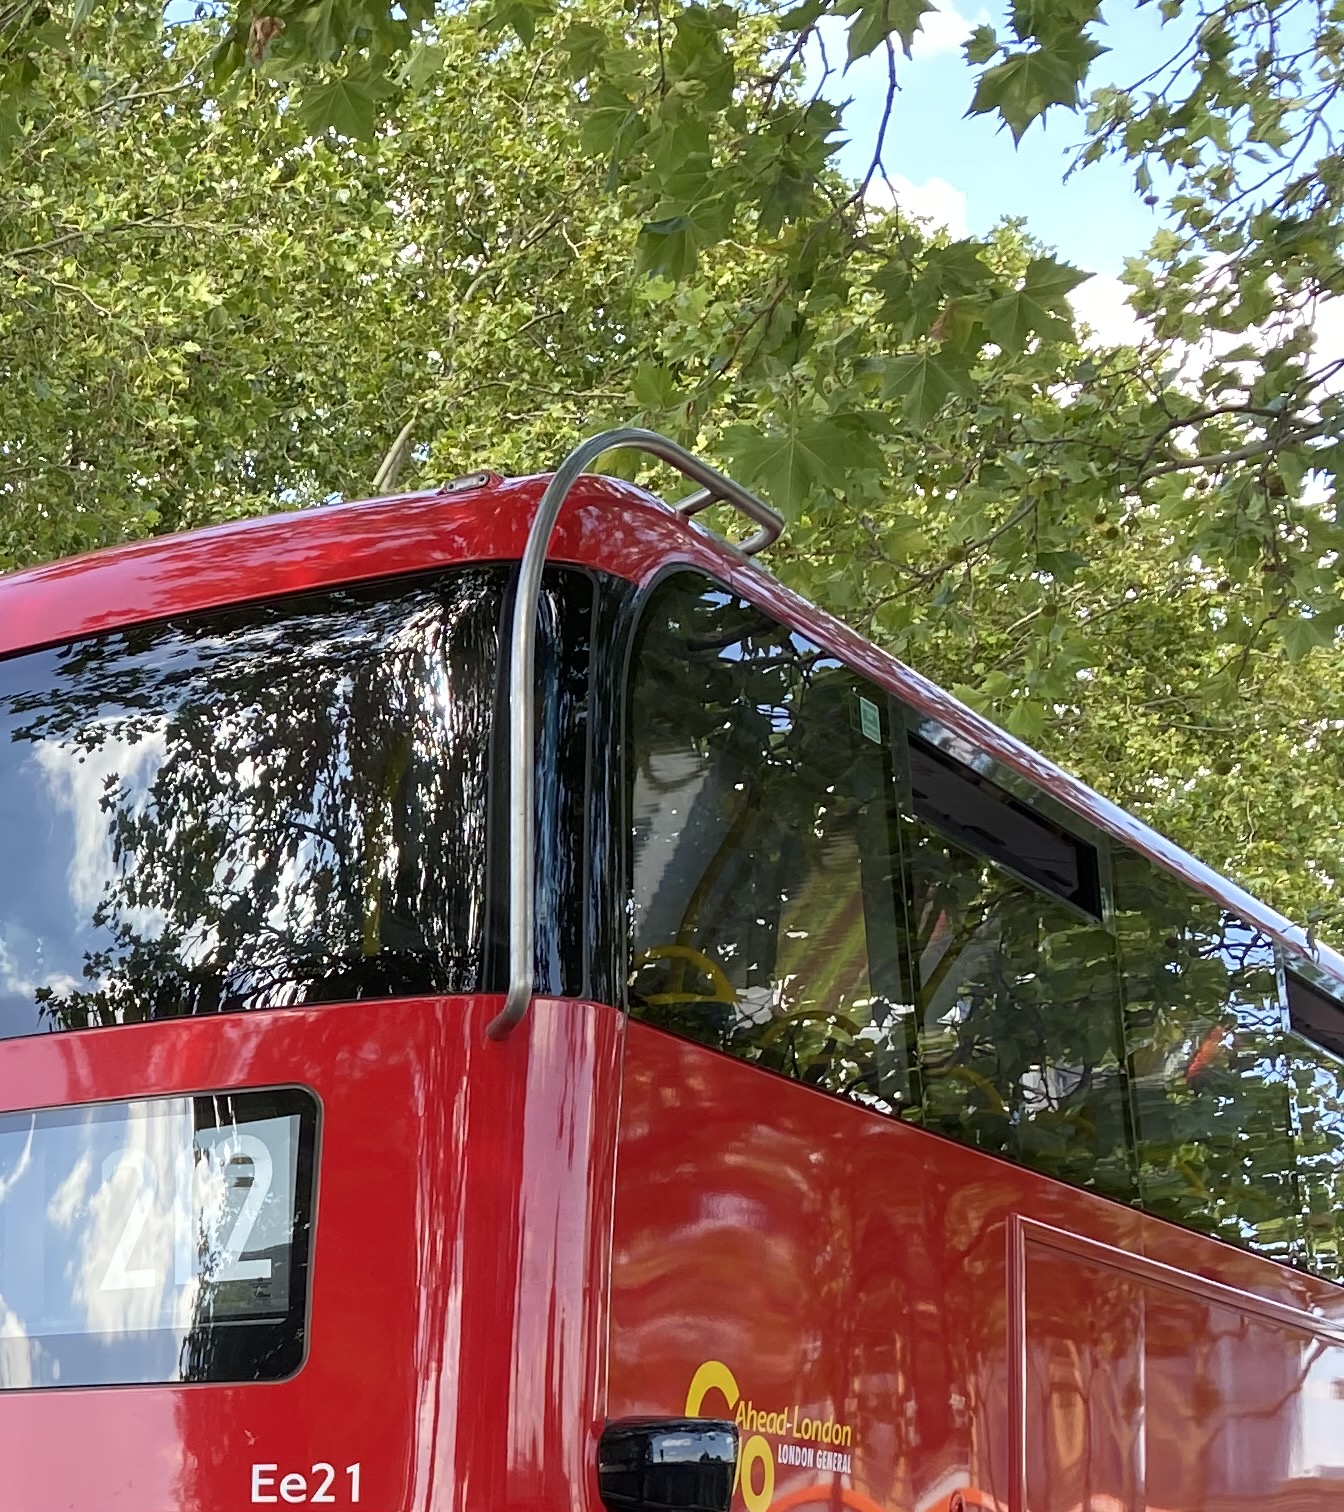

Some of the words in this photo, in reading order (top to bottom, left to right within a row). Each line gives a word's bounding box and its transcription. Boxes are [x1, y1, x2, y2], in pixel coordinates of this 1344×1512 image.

[99, 1134, 273, 1291] 212
[778, 1444, 814, 1468] LONDON
[816, 1449, 852, 1474] GENERAL
[251, 1462, 361, 1503] Ee21
